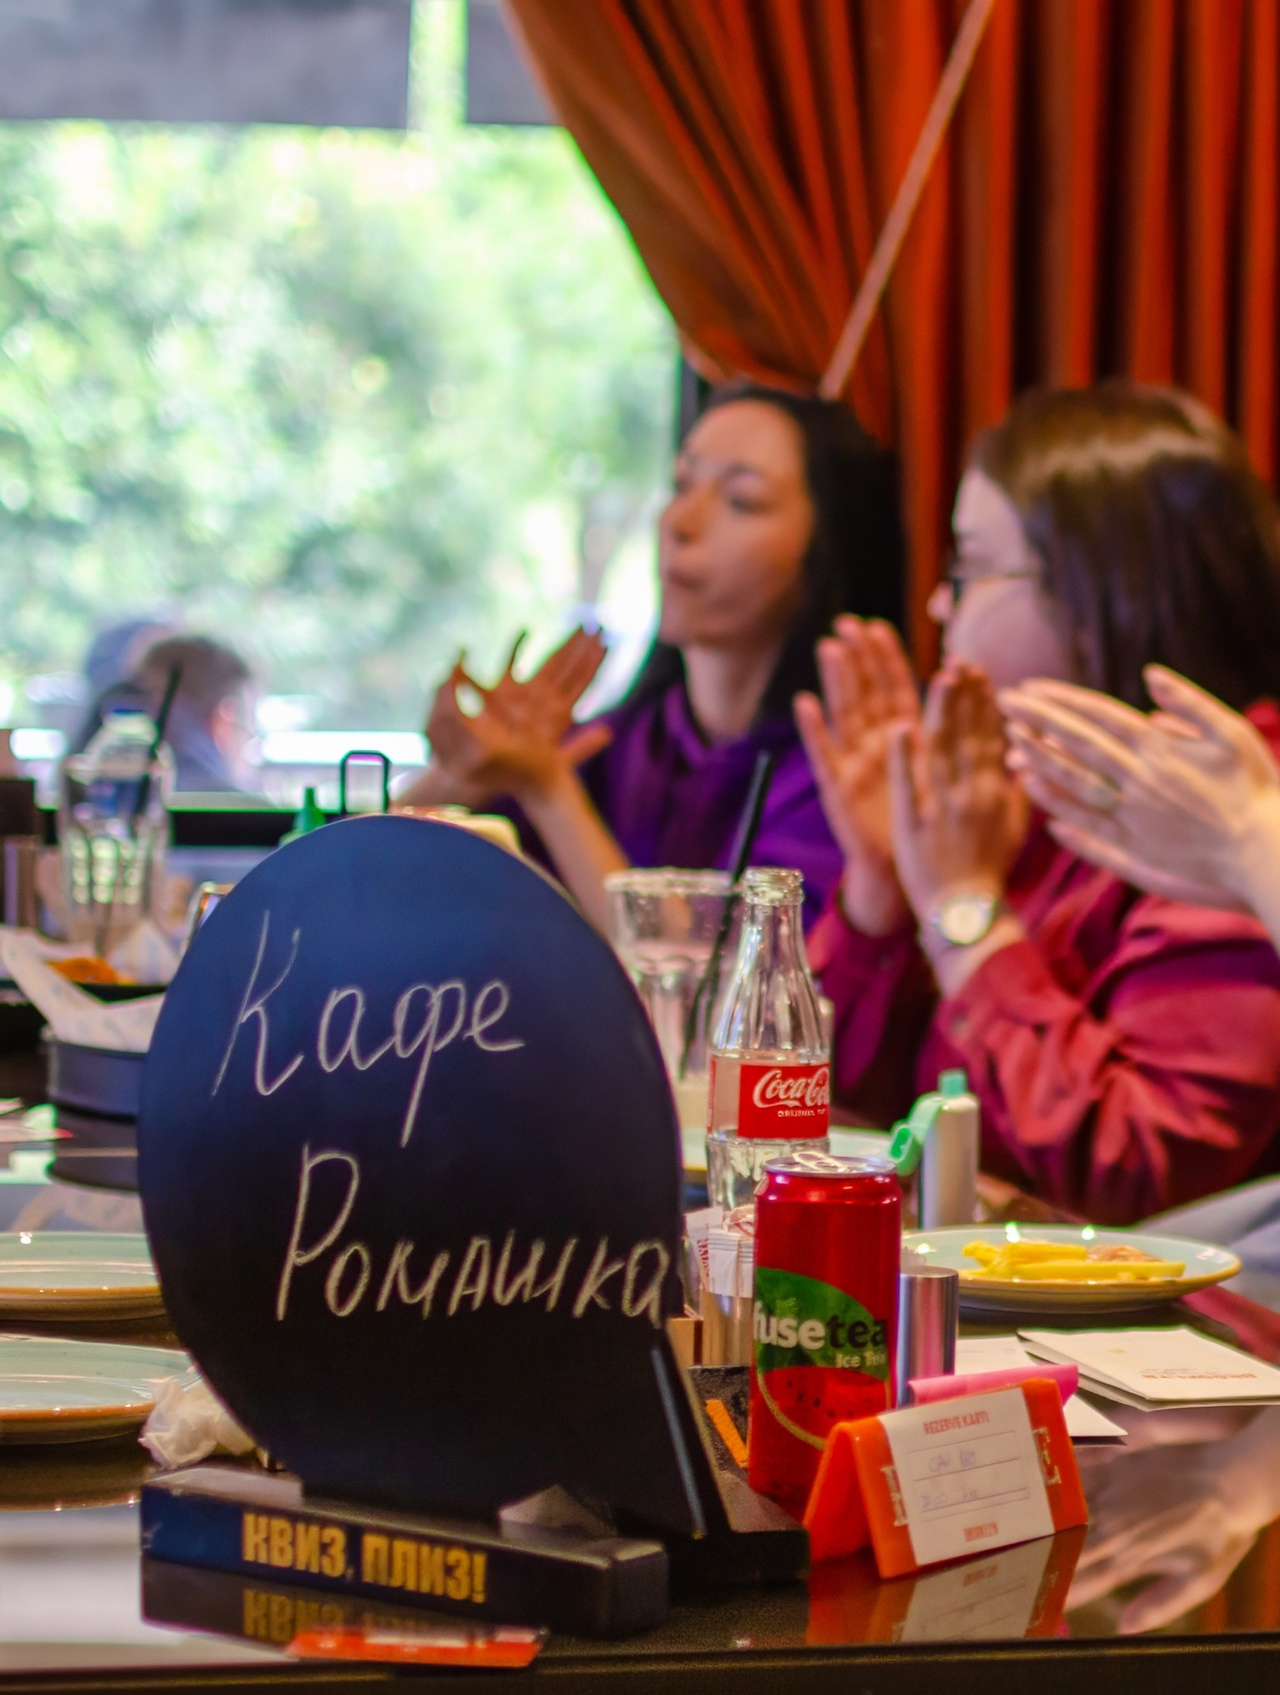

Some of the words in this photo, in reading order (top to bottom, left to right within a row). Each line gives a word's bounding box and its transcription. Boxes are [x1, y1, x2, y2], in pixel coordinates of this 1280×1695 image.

[213, 909, 525, 1149] Кафе
[276, 1141, 670, 1329] Ромашка
[836, 1353, 861, 1368] Ice
[242, 1512, 354, 1583] КВИЗ,
[361, 1533, 488, 1605] ПЛИЗ!
